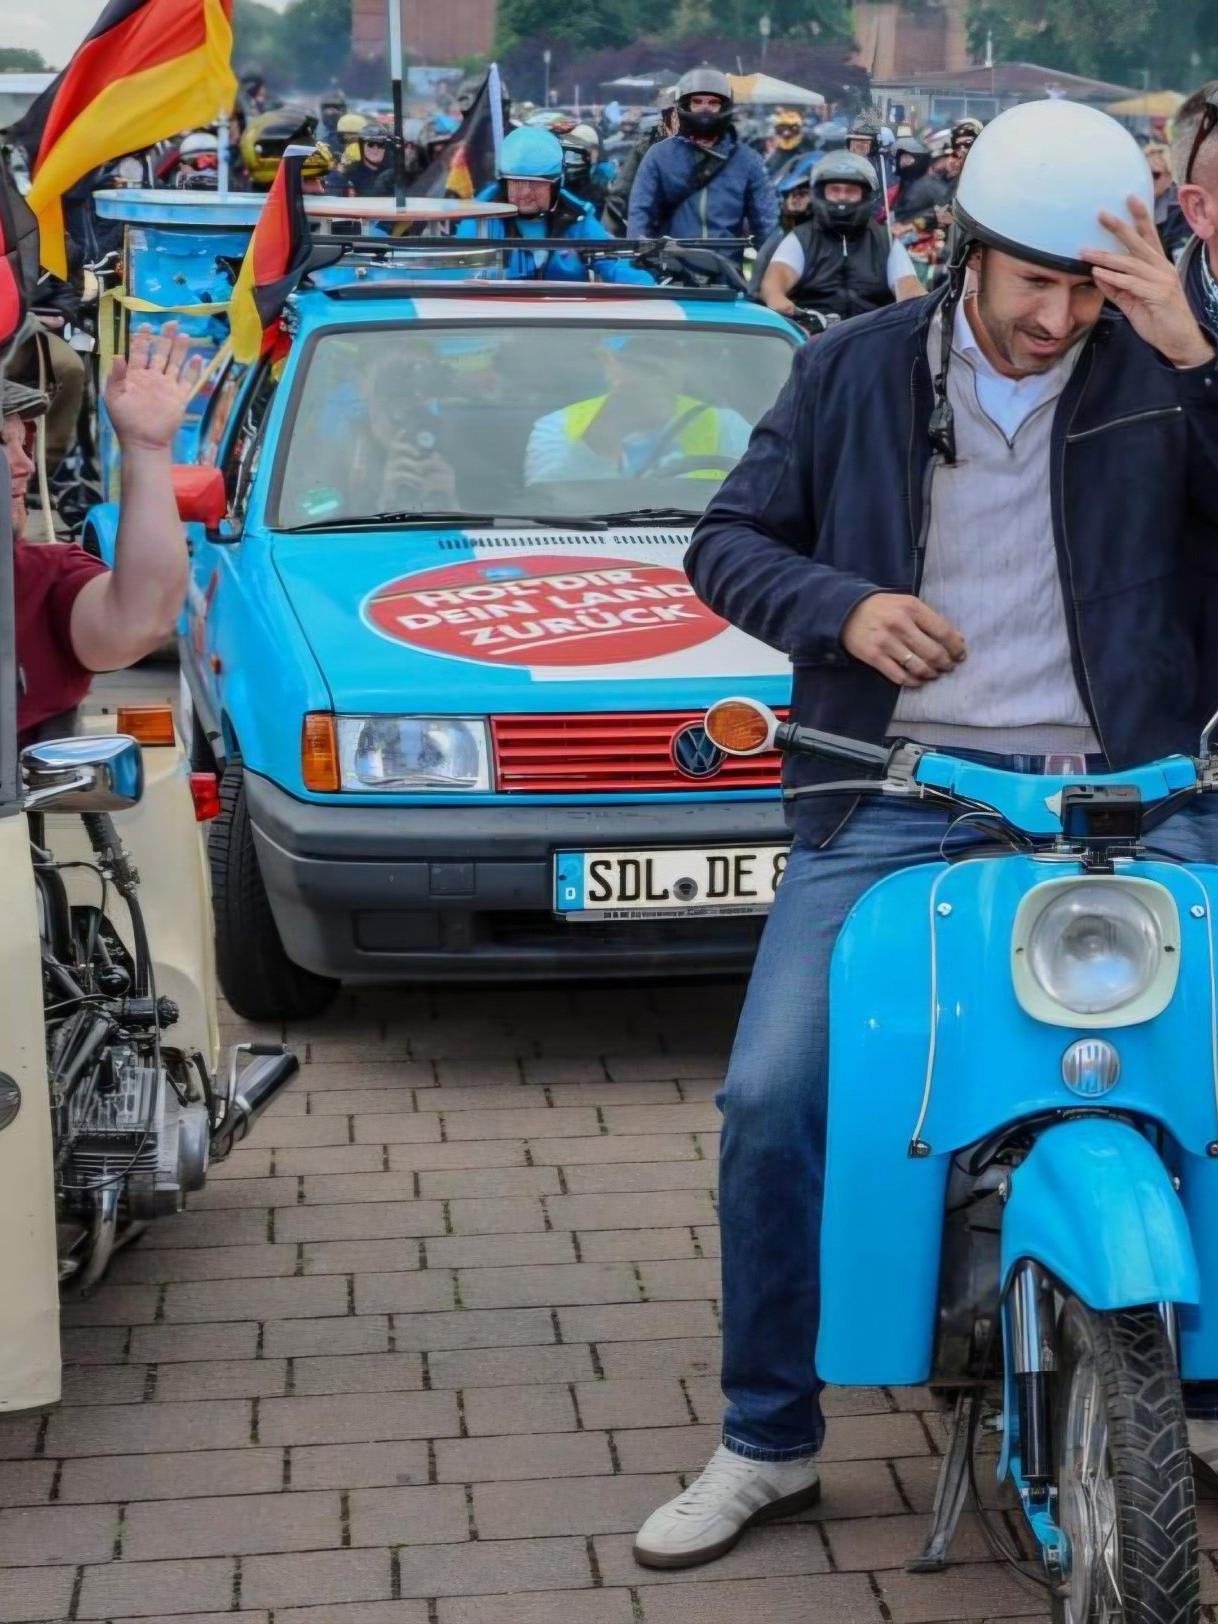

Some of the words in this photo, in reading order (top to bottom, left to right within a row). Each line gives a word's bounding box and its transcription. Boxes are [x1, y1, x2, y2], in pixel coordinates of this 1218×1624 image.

[396, 600, 539, 630] DEIN
[546, 584, 696, 609] LAND
[459, 604, 704, 646] ZURÜCK
[589, 858, 670, 901] SDL
[706, 855, 757, 898] DE
